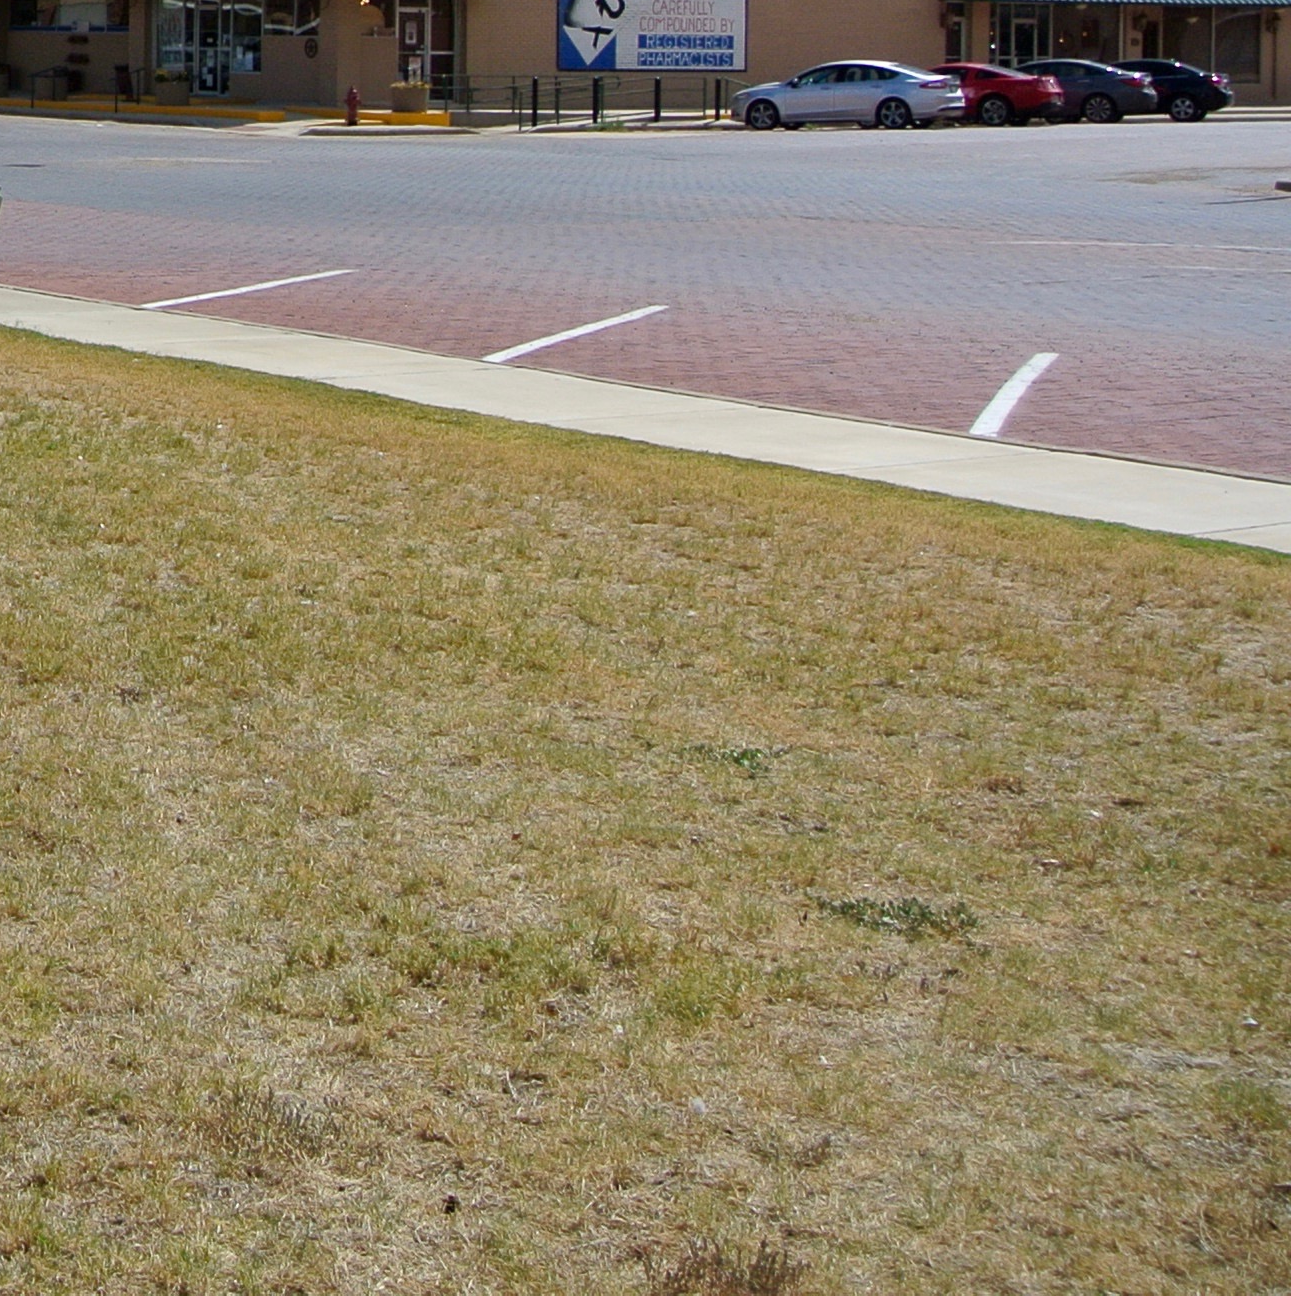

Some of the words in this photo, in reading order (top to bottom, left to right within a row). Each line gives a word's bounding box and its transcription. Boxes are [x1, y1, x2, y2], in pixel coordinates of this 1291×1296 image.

[652, 0, 715, 16] CAREFULLY
[639, 16, 716, 33] COMPOUNDED
[721, 18, 735, 33] BY
[646, 34, 729, 49] REGISTERED
[638, 51, 731, 67] PHARMACISTS
